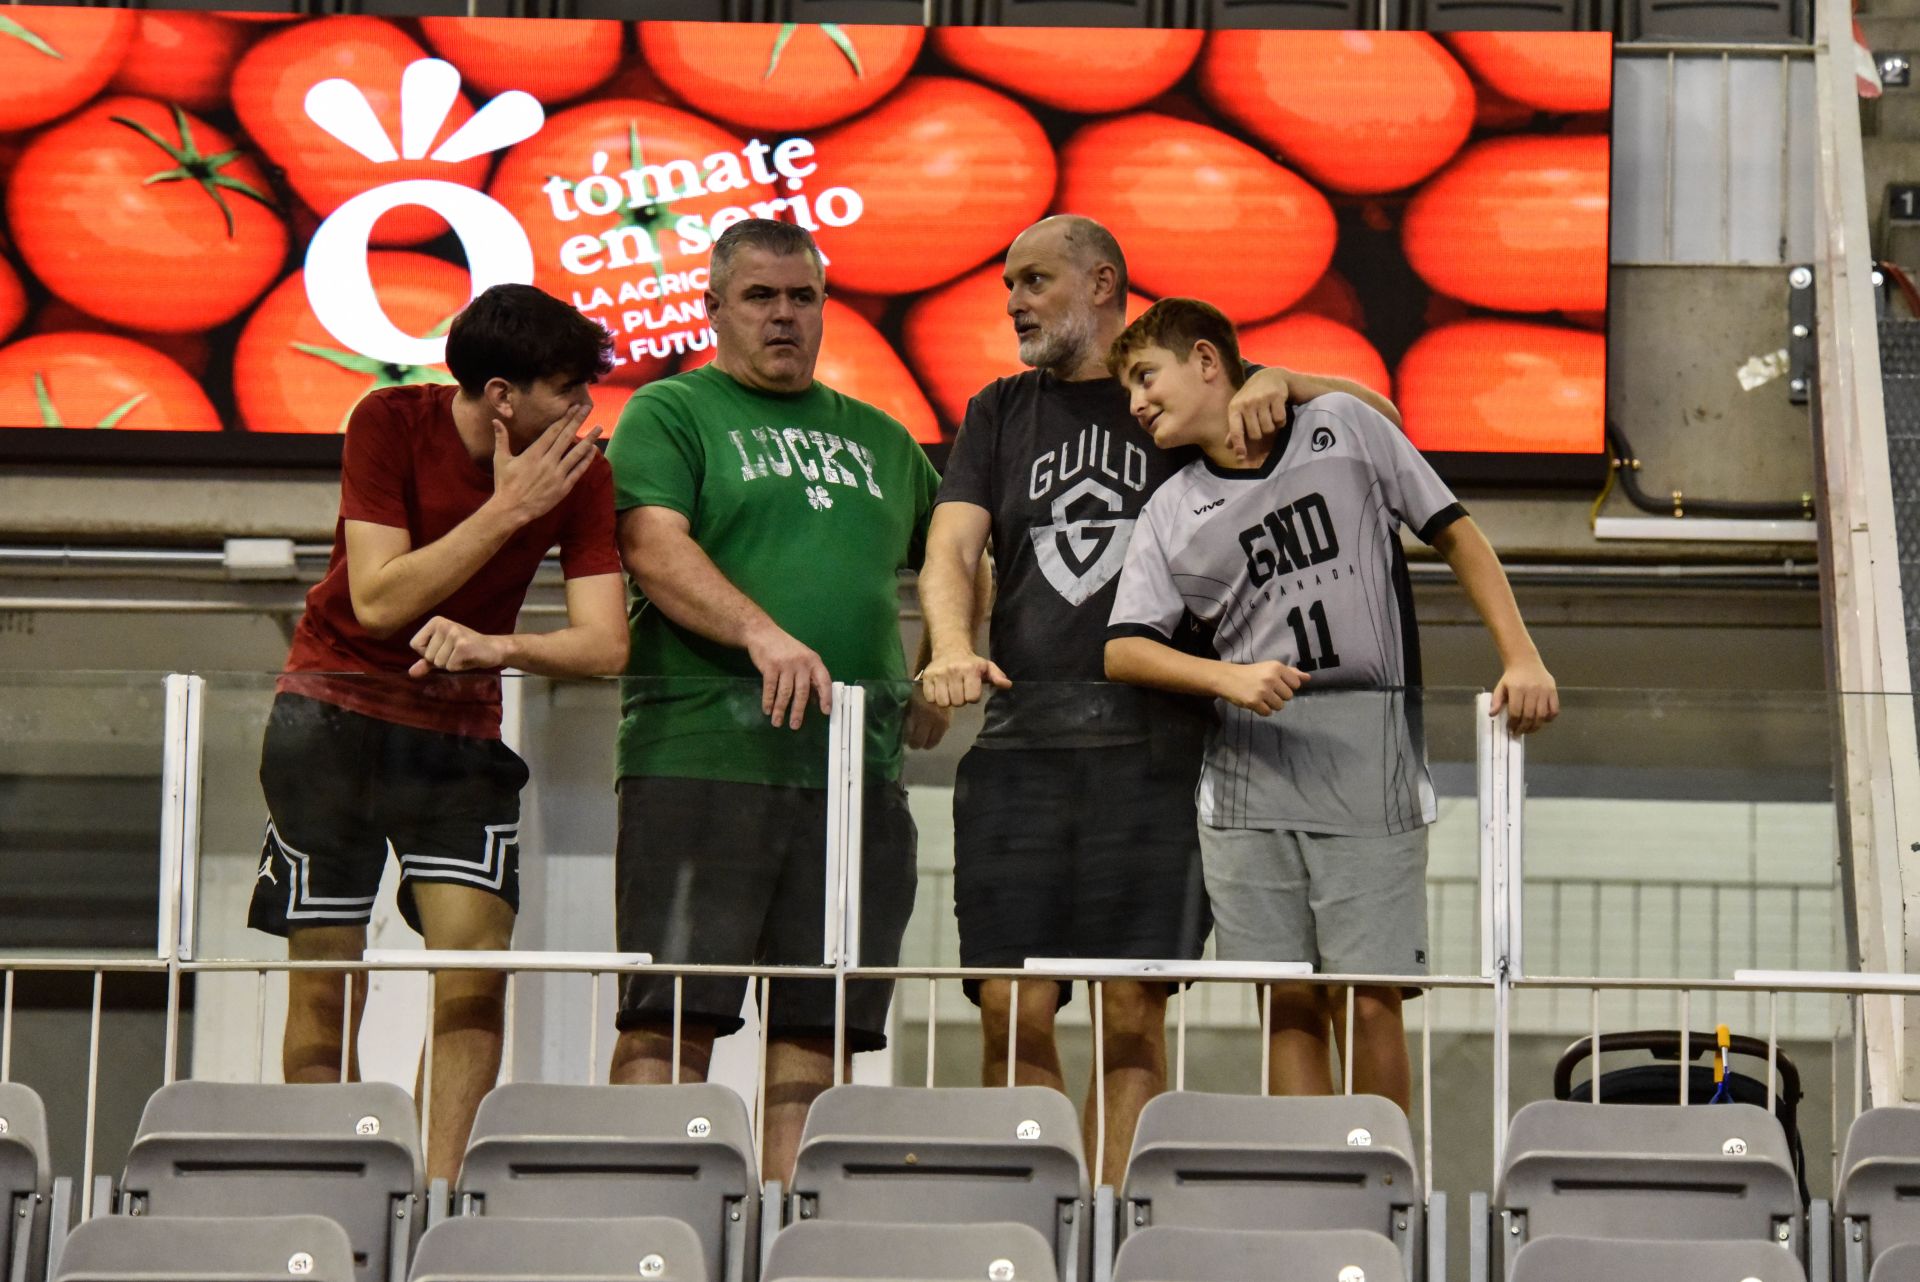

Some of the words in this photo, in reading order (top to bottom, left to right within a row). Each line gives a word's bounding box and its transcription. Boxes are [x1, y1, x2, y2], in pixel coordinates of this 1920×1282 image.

[542, 137, 817, 221] tómate
[1901, 191, 1913, 215] 1
[560, 224, 662, 275] en
[572, 287, 614, 311] LA
[618, 267, 709, 304] AGRIC
[728, 425, 883, 500] LUCKY
[1029, 423, 1147, 500] GUILD
[1237, 491, 1340, 589] GND
[1250, 564, 1355, 609] GRANADA
[1286, 600, 1341, 672] 11
[361, 1122, 375, 1132] 51
[691, 1123, 706, 1134] 49
[1727, 1144, 1744, 1155] 43
[294, 1260, 308, 1270] 51
